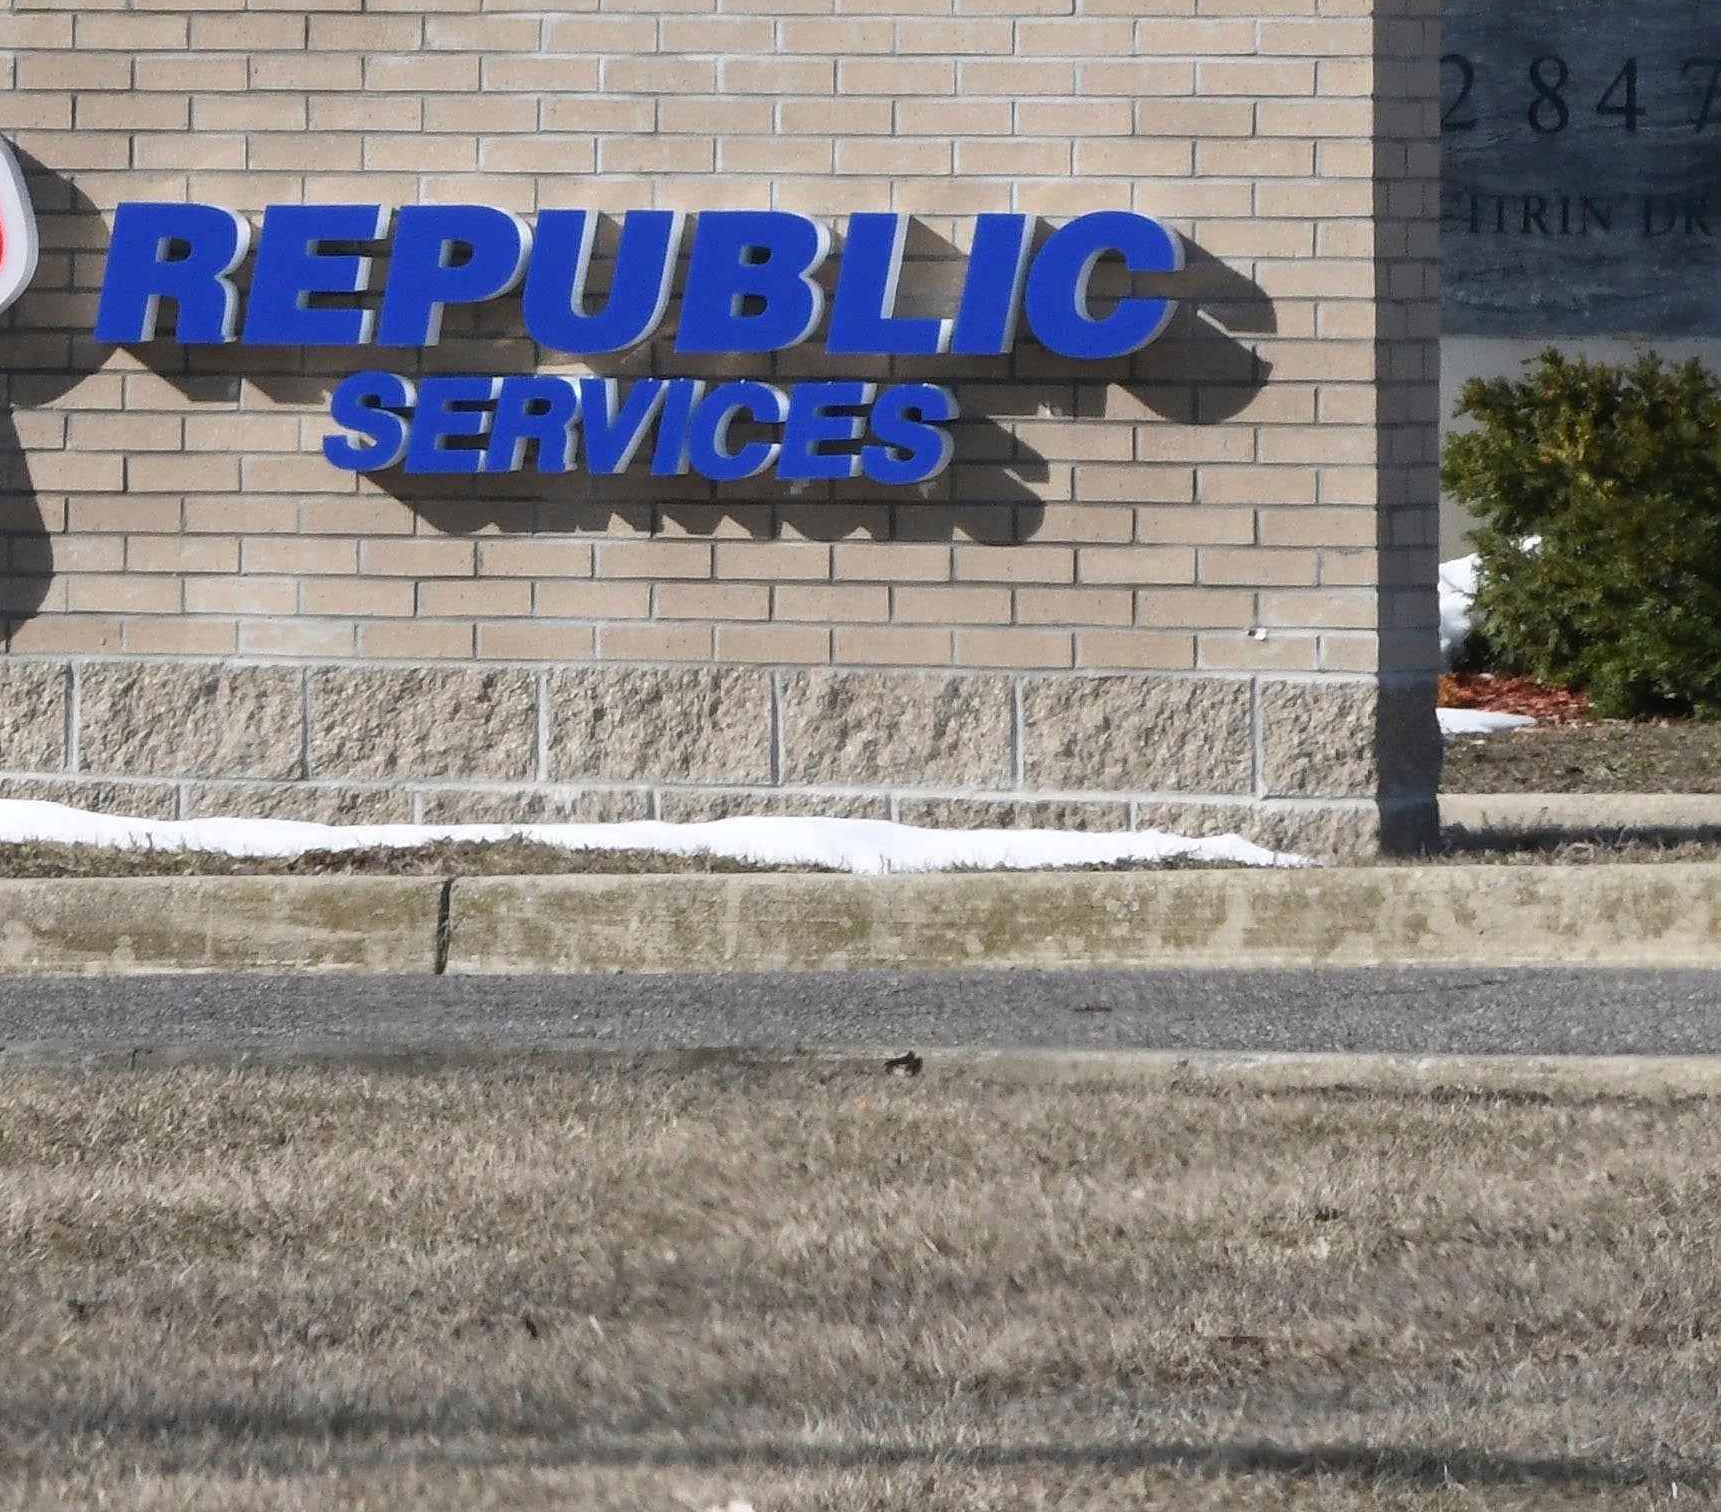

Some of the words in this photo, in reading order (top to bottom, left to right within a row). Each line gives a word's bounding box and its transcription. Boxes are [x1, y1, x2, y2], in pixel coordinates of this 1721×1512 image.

[1440, 193, 1614, 235] ITRIN
[94, 202, 1186, 361] REPUBLIC
[323, 371, 960, 486] SERVICES
